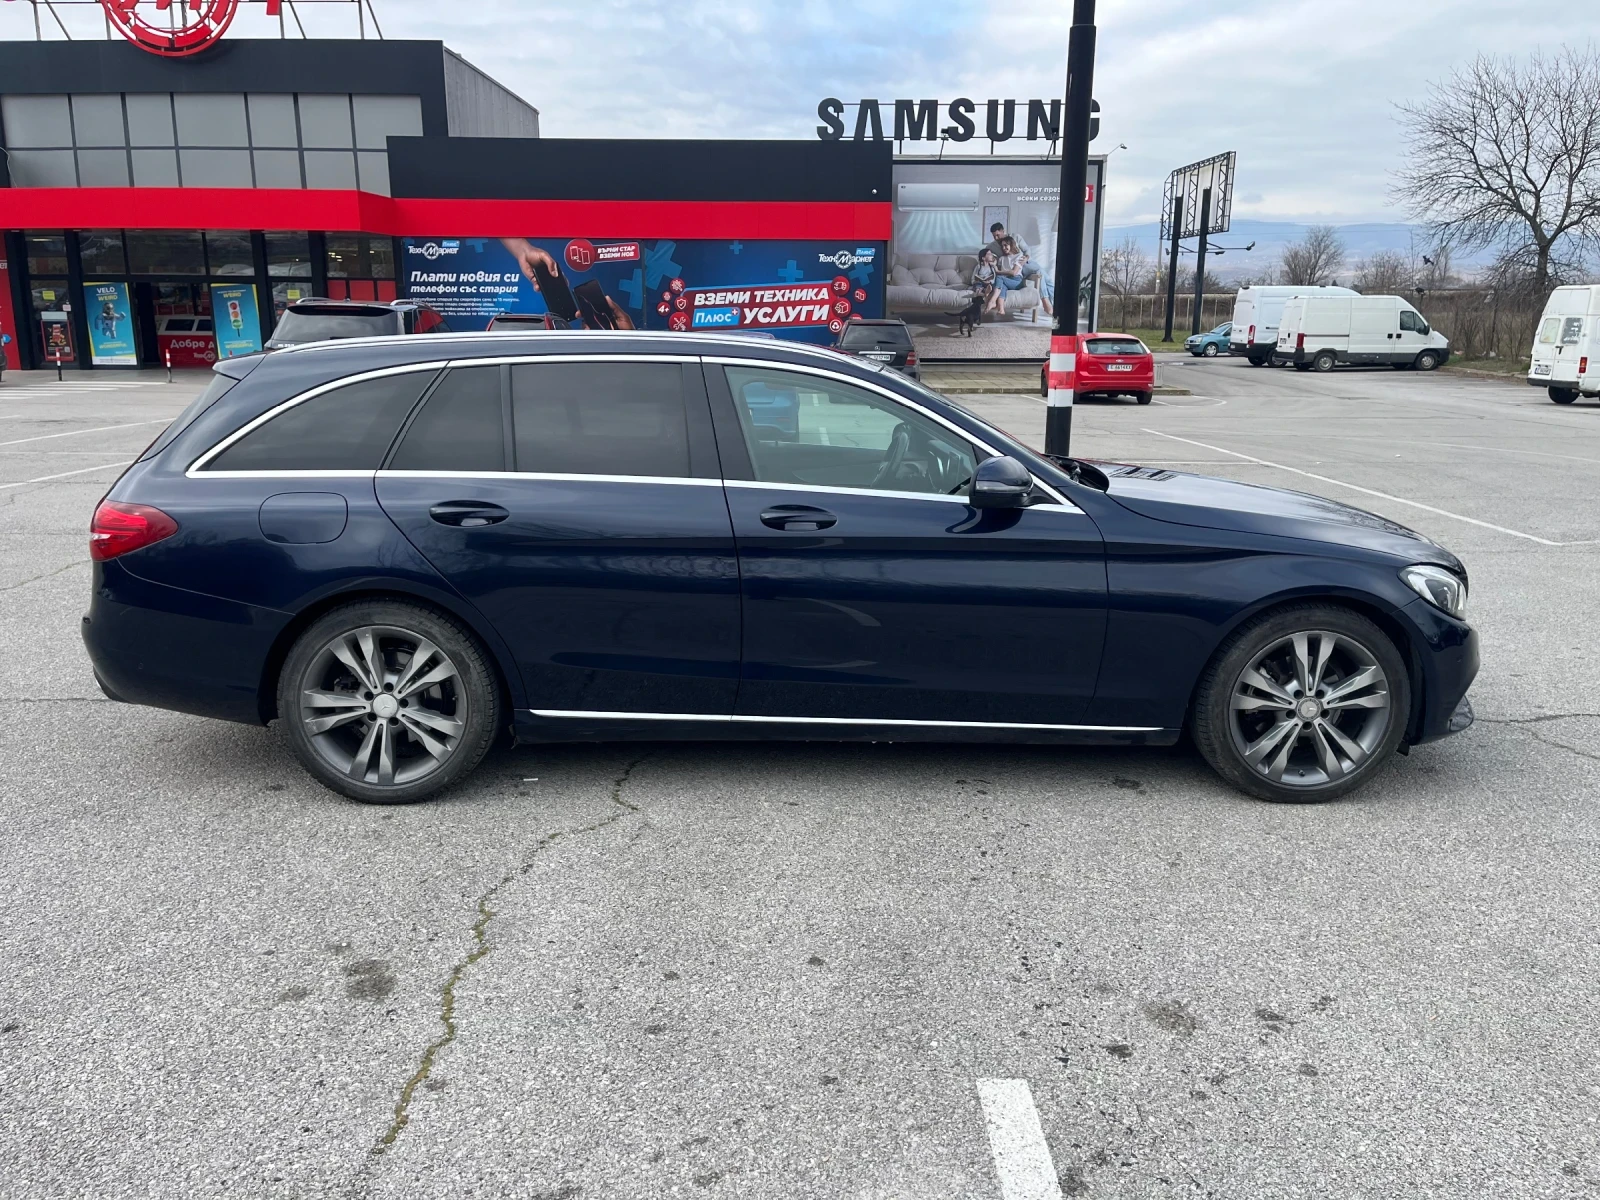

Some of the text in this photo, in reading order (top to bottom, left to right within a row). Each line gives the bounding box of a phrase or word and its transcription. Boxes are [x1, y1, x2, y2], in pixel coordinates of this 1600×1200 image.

[1009, 186, 1043, 194] комфорт
[410, 271, 520, 283] Плати новия си
[96, 286, 115, 294] VELO
[410, 284, 519, 295] телефон със стария
[694, 287, 830, 306] ВЗЕМИ ТЕХНИКА
[743, 304, 830, 324] УСЛУГИ
[170, 339, 205, 350] Добре
